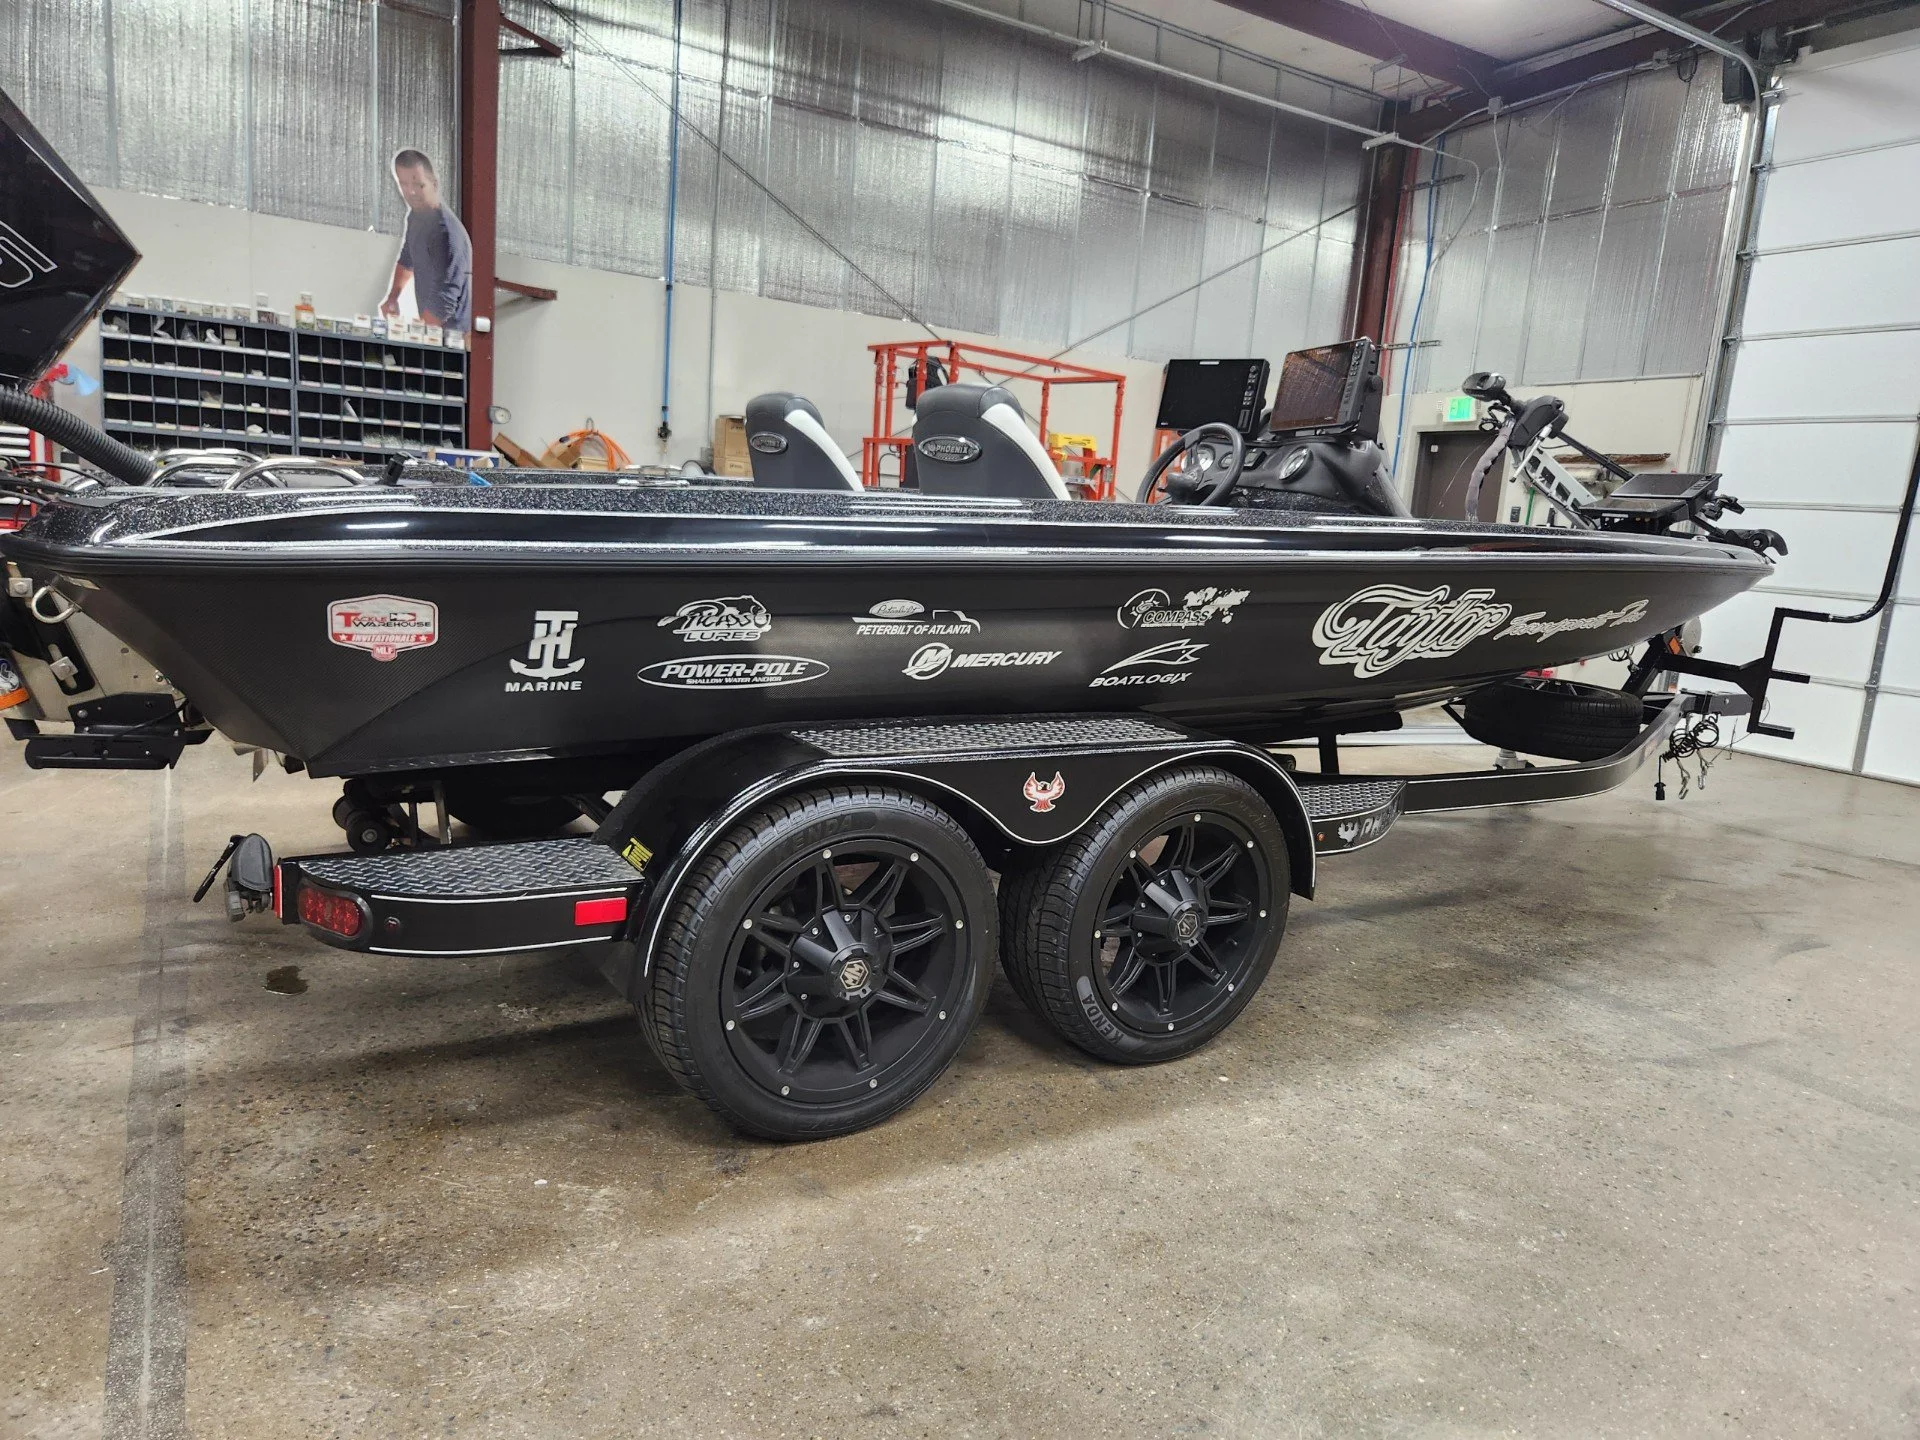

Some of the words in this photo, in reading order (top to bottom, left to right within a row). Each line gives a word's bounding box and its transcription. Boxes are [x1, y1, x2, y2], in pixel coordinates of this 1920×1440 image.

[935, 445, 969, 455] PHOENIX
[335, 612, 388, 628] TACKLE
[1142, 609, 1210, 623] COMPASS
[683, 630, 761, 642] LURES
[856, 624, 914, 635] PETERBILT
[912, 624, 930, 635] OF
[928, 624, 972, 635] ATLANTA
[1312, 583, 1513, 679] Taylor
[351, 633, 417, 643] INVITATIONALS
[375, 646, 395, 656] MLF
[950, 651, 1064, 669] MERCURY
[660, 662, 809, 679] POWER-POLE
[504, 680, 583, 693] MARINE
[686, 677, 724, 685] SHALLOW
[724, 676, 752, 684] WATER
[752, 675, 783, 683] ANCHOR
[1088, 672, 1193, 688] BOATLOGIX
[1081, 993, 1125, 1044] KENDA
